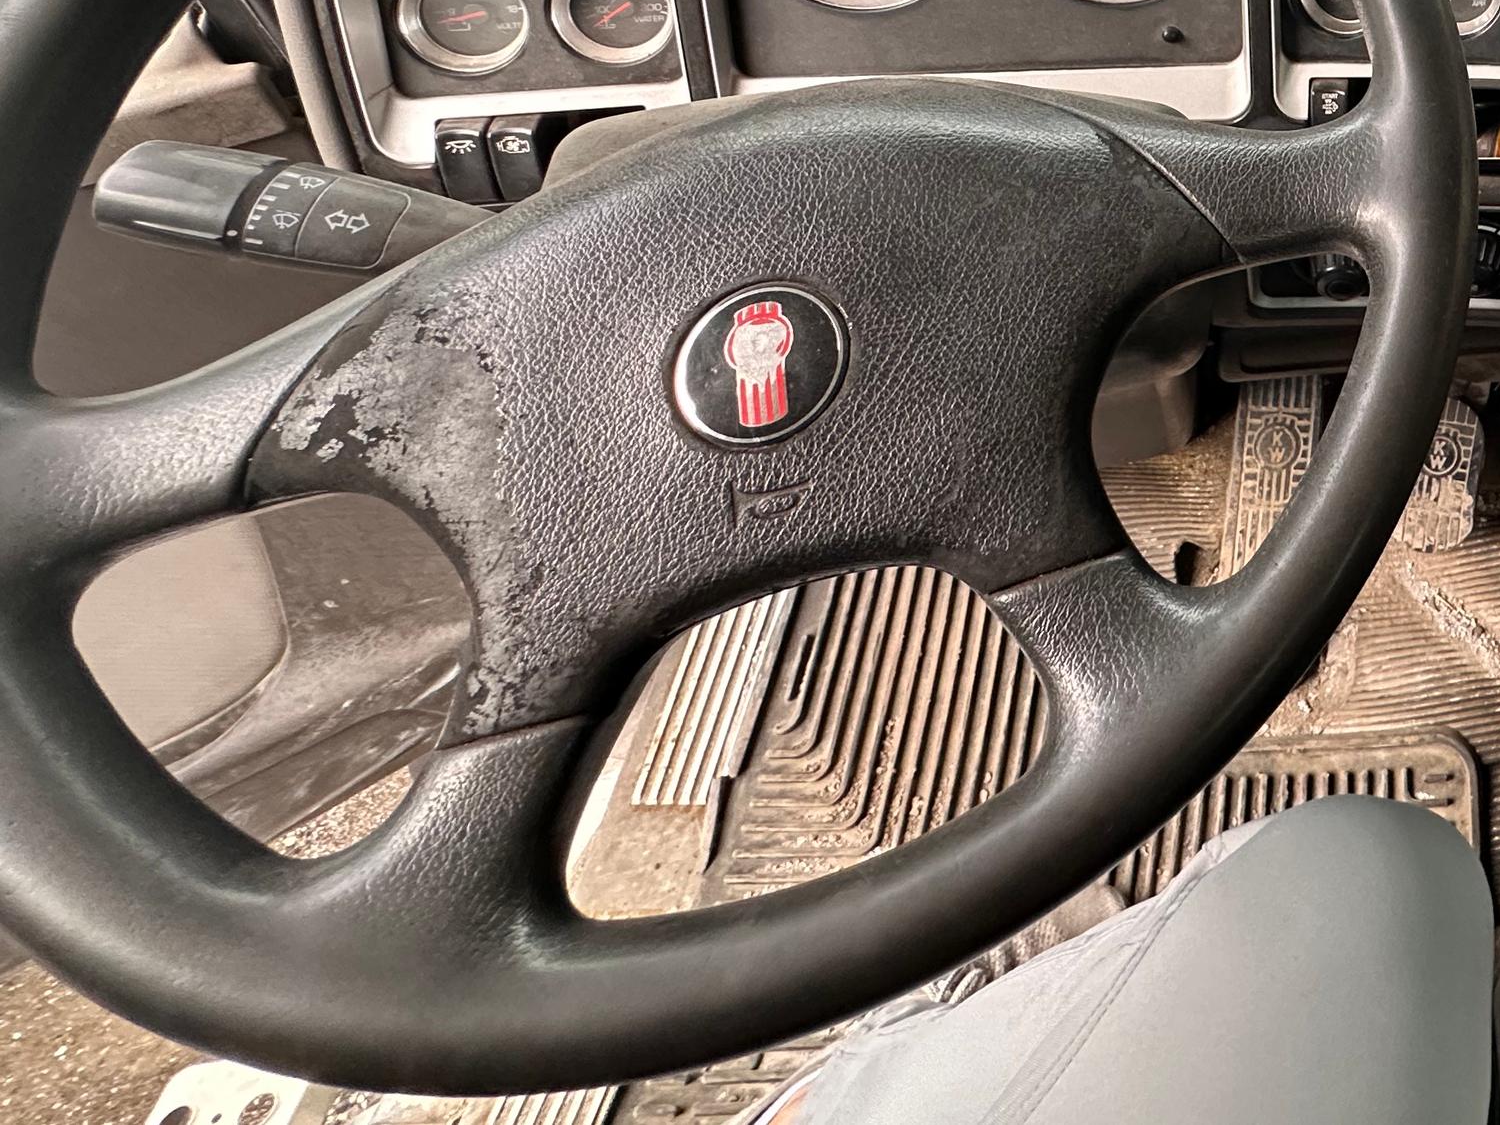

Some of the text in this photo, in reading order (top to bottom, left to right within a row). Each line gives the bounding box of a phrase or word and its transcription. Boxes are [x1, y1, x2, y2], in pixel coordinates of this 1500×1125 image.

[1271, 431, 1282, 447] K
[1268, 447, 1286, 463] W
[1433, 440, 1446, 455] K
[1430, 454, 1447, 470] W
